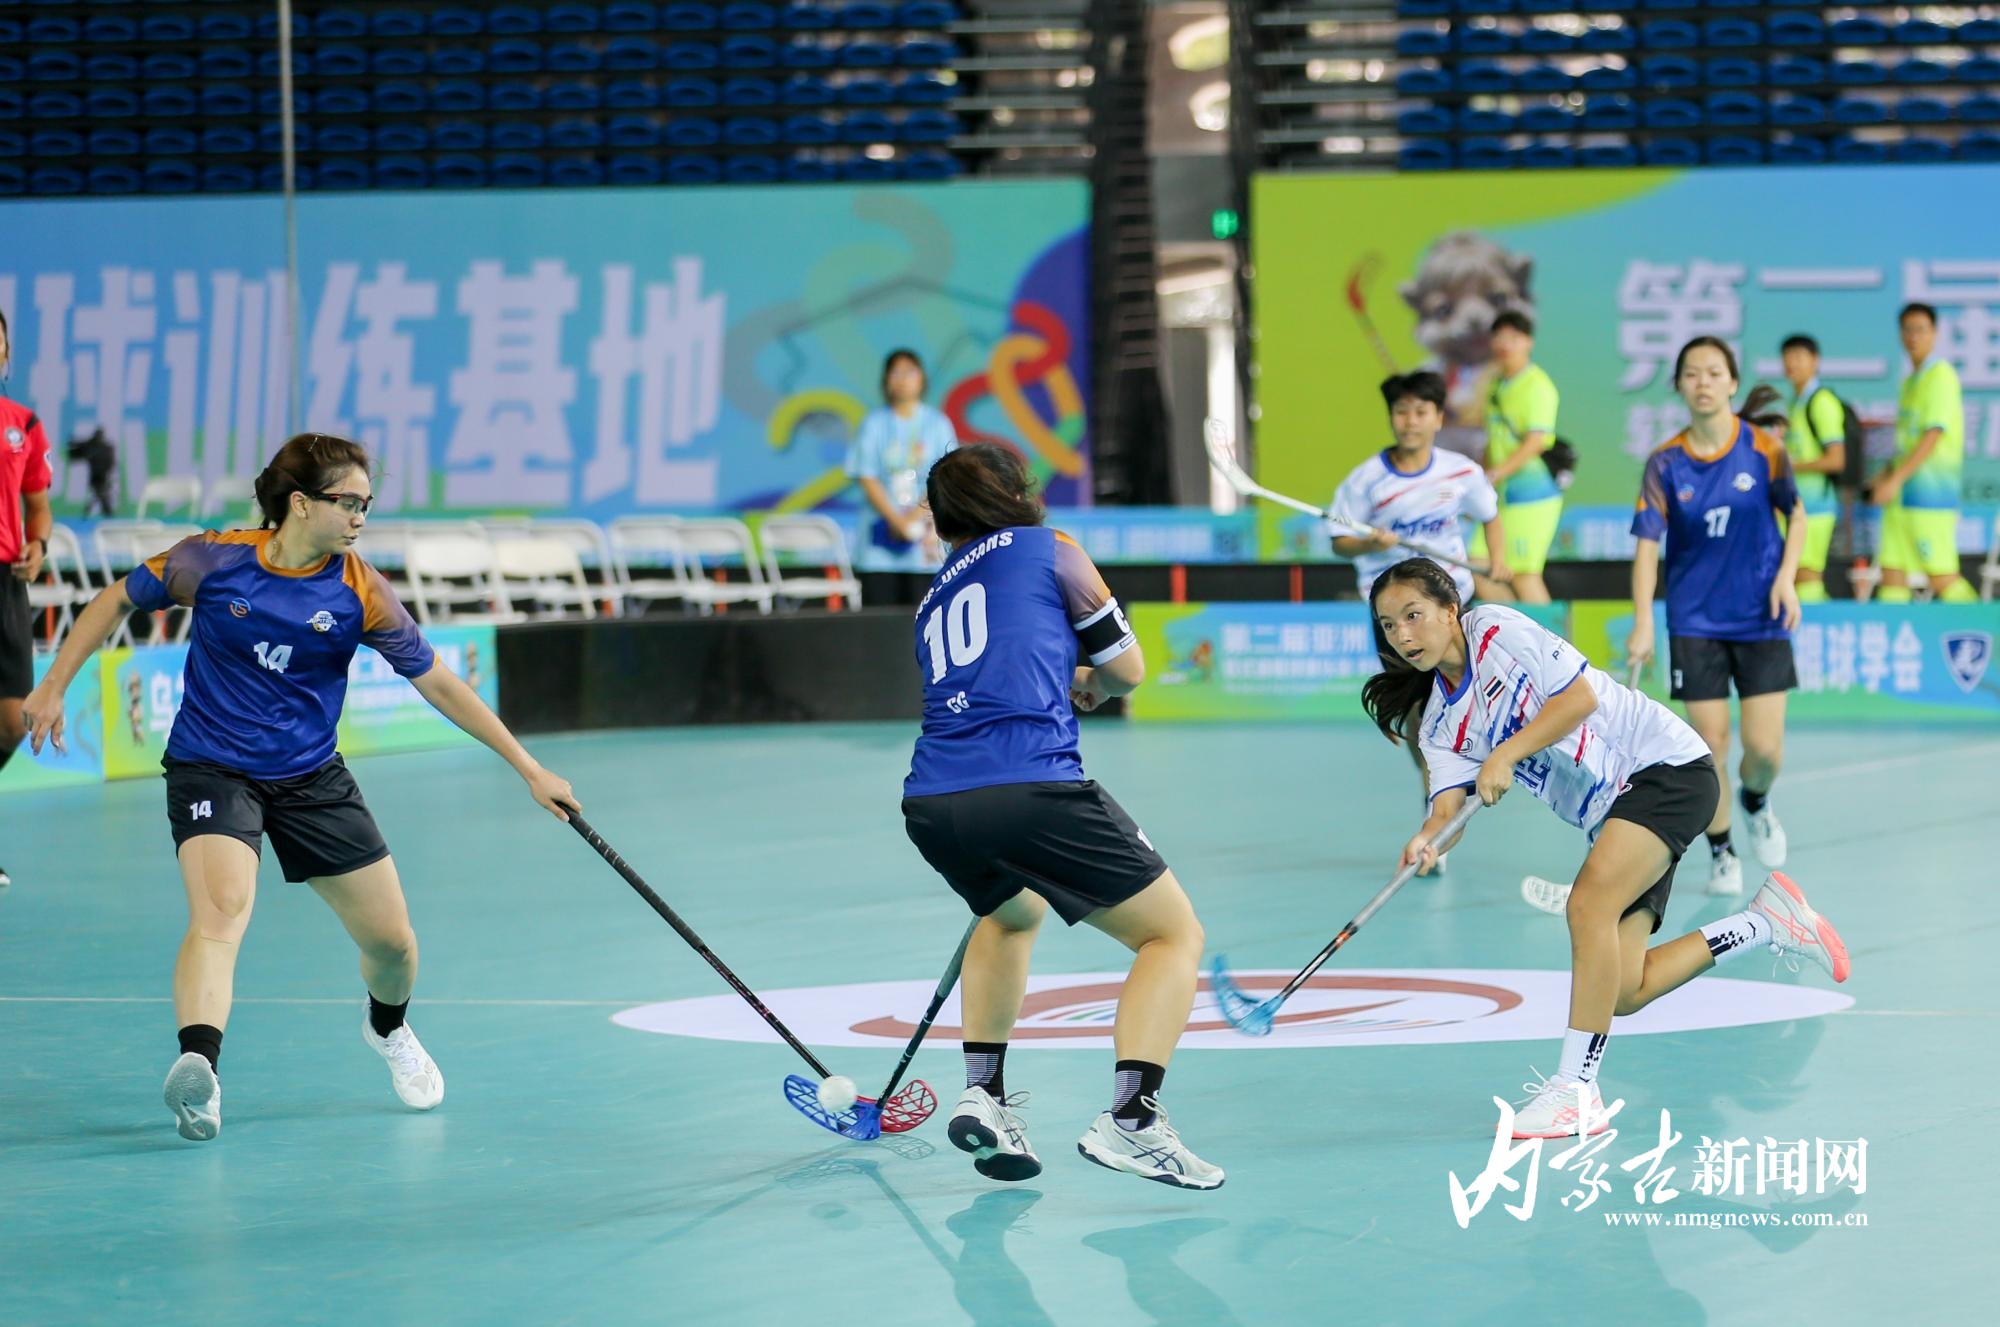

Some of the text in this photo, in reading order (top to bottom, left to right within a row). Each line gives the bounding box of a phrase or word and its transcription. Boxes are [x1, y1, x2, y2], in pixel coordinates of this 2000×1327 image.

[1618, 259, 2000, 392] 第二届
[0, 257, 726, 511] 球训练基地
[1703, 506, 1731, 538] 17
[253, 641, 294, 674] 14
[923, 582, 989, 685] 10
[189, 800, 213, 820] 14
